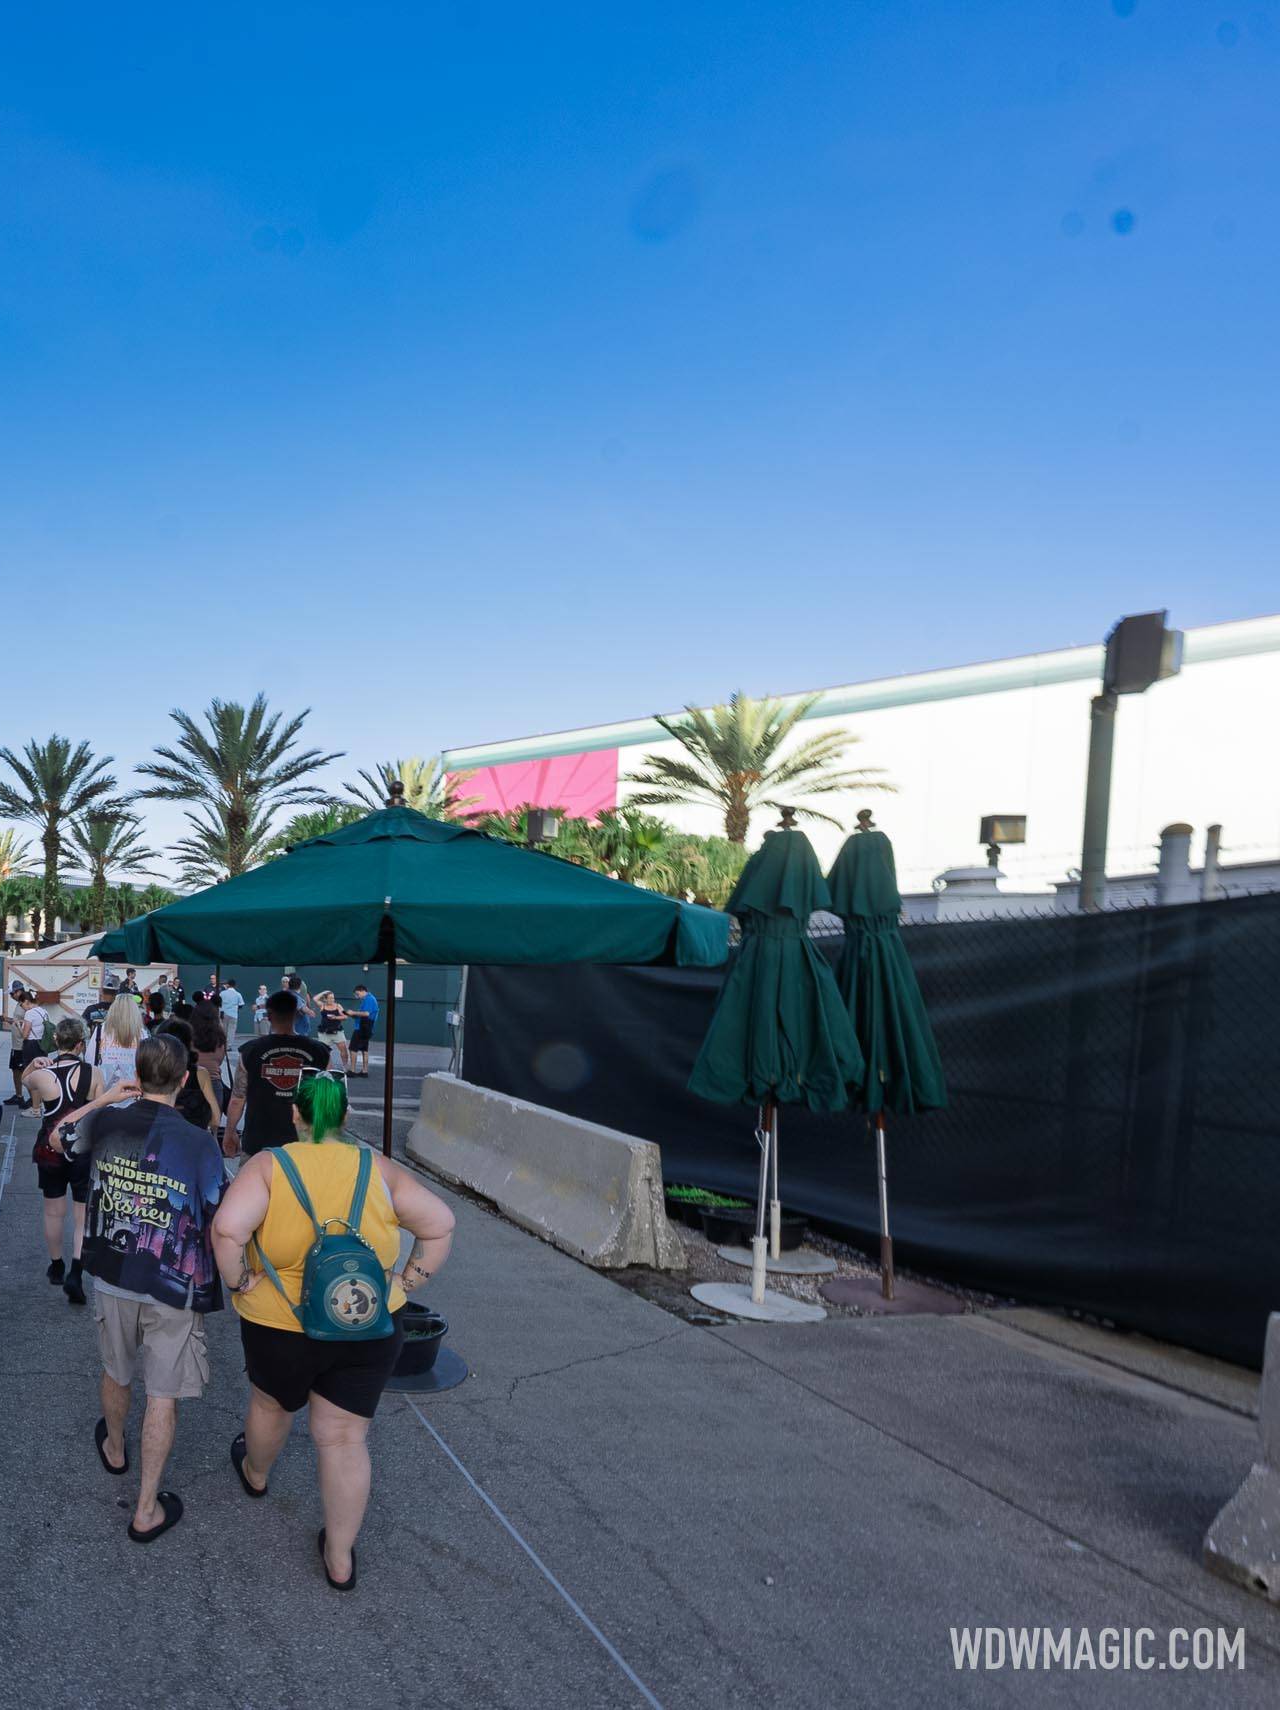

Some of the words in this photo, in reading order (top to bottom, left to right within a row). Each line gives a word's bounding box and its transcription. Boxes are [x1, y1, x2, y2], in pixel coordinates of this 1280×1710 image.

[113, 1156, 138, 1169] THE
[96, 1160, 188, 1195] WONDERFUL
[108, 1176, 168, 1199] WORLD
[102, 1180, 172, 1229] Disney
[140, 1197, 156, 1205] OF
